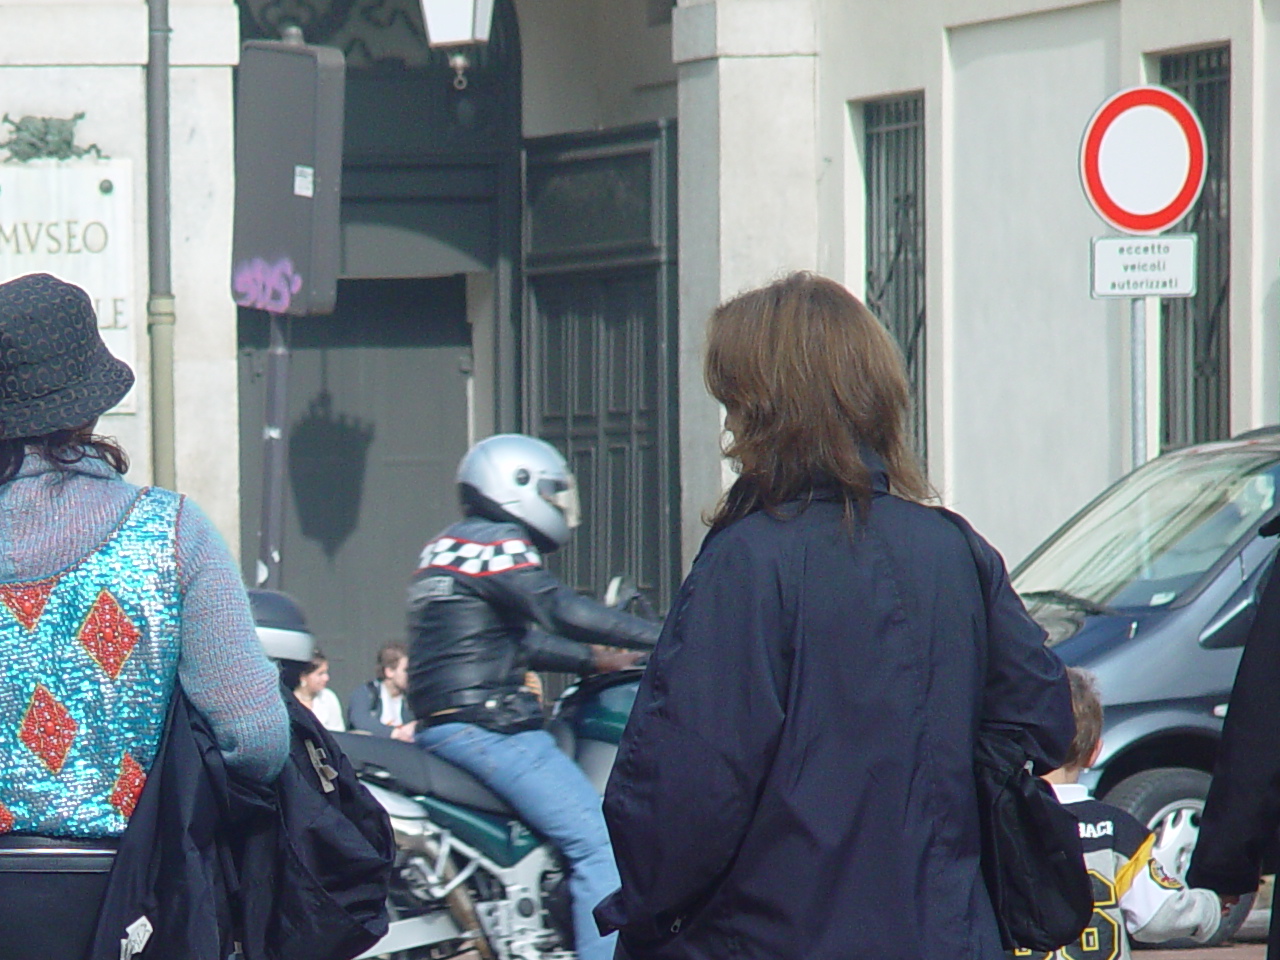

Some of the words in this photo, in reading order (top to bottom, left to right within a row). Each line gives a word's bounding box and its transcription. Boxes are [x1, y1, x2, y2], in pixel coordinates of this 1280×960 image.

[1118, 243, 1170, 255] eccetto
[1122, 261, 1166, 272] veicoli
[1110, 279, 1178, 290] autorizzati
